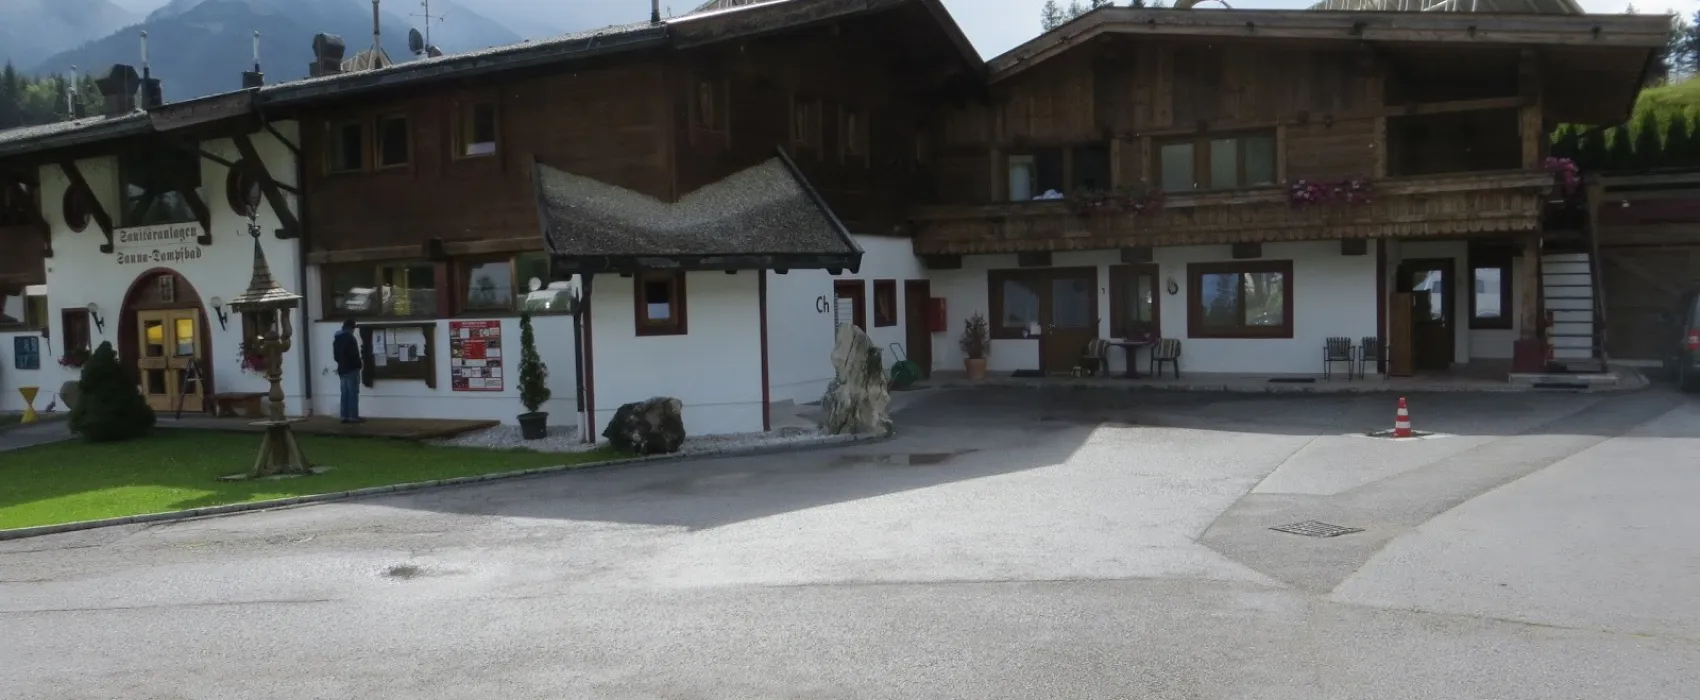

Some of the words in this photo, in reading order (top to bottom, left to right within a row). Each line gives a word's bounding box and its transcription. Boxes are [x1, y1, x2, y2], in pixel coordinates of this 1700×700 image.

[120, 226, 197, 243] Sanitäranlagen
[117, 247, 202, 265] Sauna-Dampfbad
[816, 295, 830, 313] Ch
